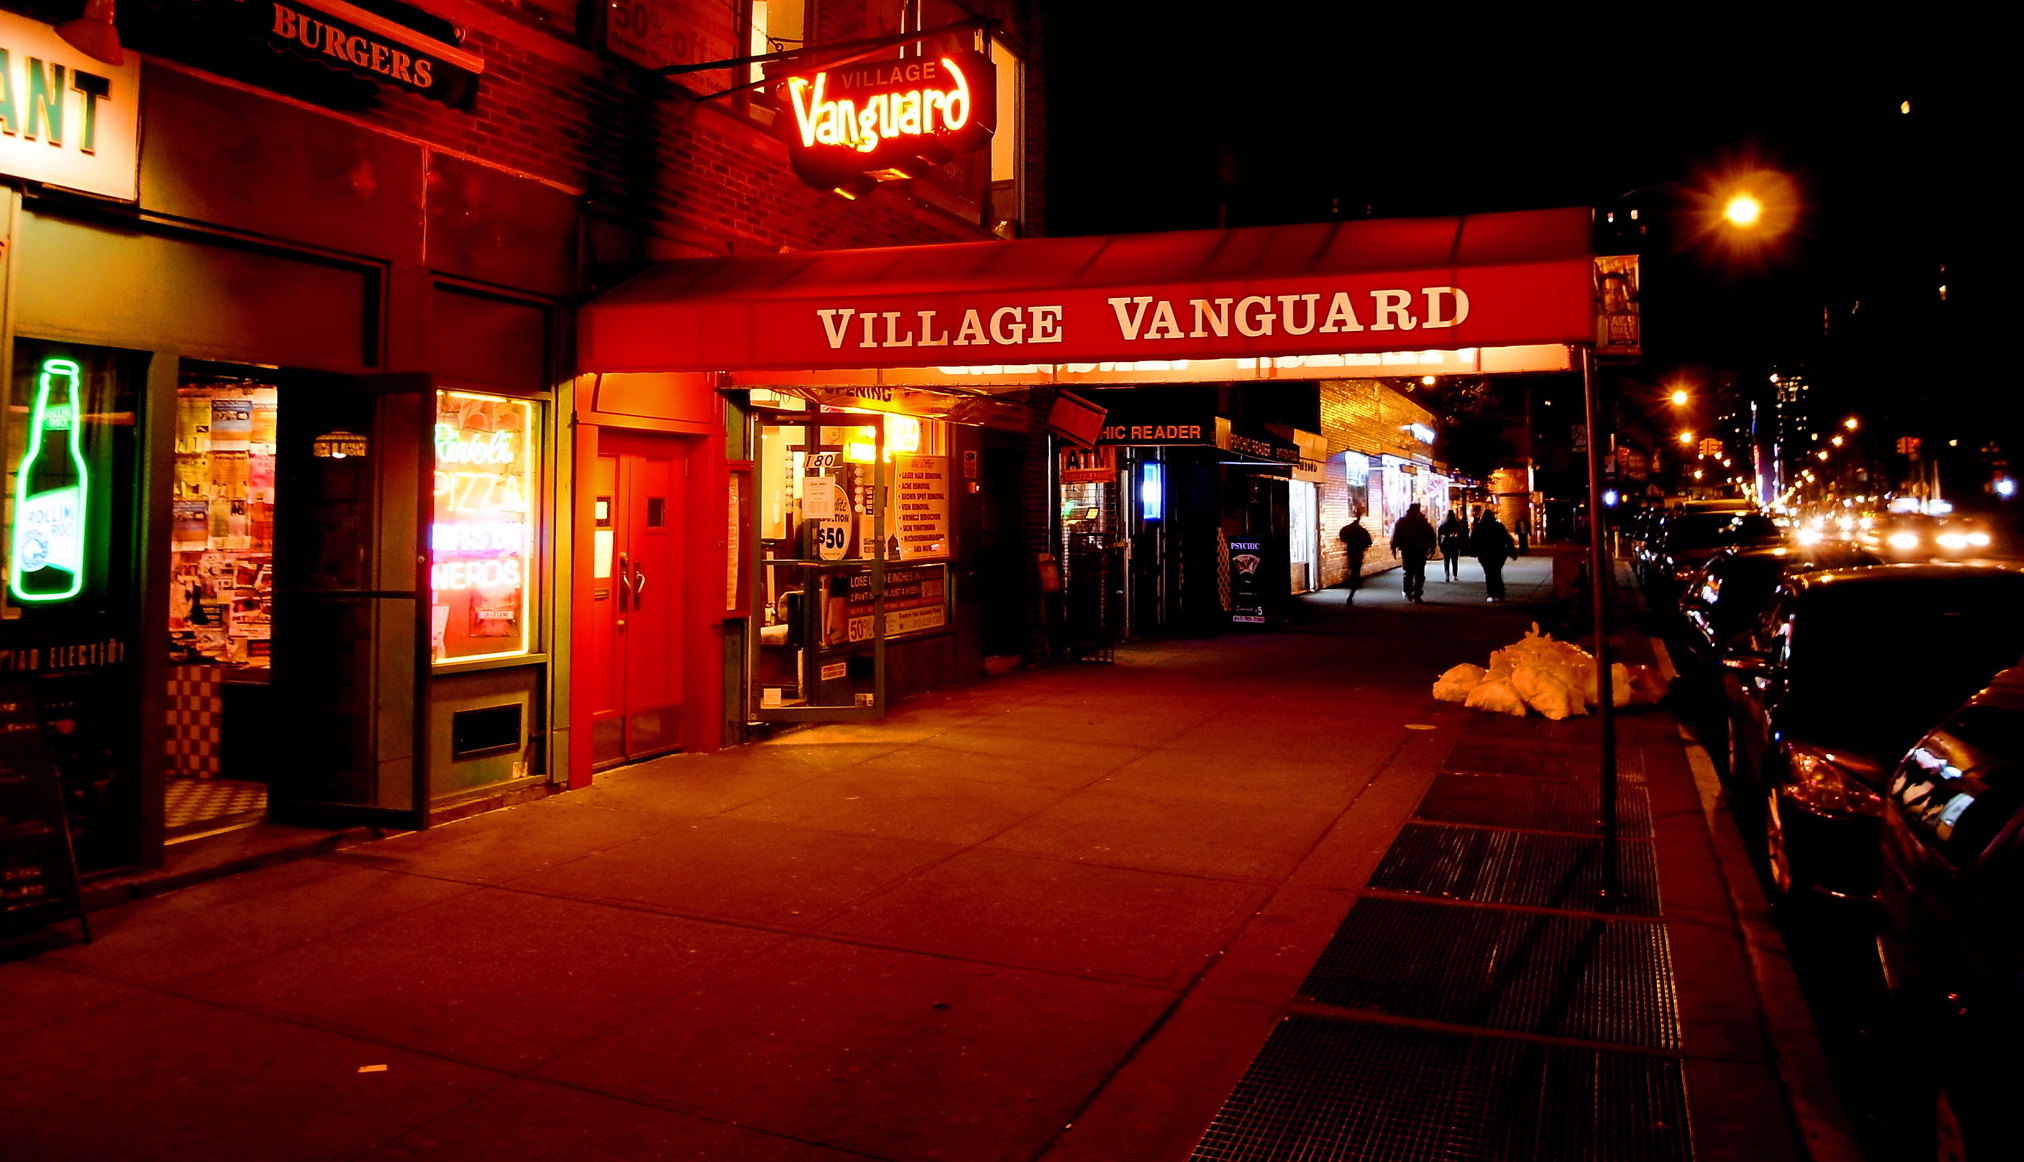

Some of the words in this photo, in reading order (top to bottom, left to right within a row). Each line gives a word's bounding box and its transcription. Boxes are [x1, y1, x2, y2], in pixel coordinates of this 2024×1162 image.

[272, 2, 433, 88] BURGERS
[843, 62, 936, 89] VILLAGE
[788, 58, 970, 153] Vanguard
[817, 305, 1063, 349] VILLAGE
[1108, 286, 1471, 341] VANGUARD
[1131, 424, 1201, 440] READER
[806, 455, 834, 467] 180
[1066, 448, 1107, 469] ATM
[434, 471, 529, 512] PIZZA
[819, 527, 845, 549] $50
[1230, 542, 1260, 550] PSYCHIC
[850, 576, 868, 588] LOSE
